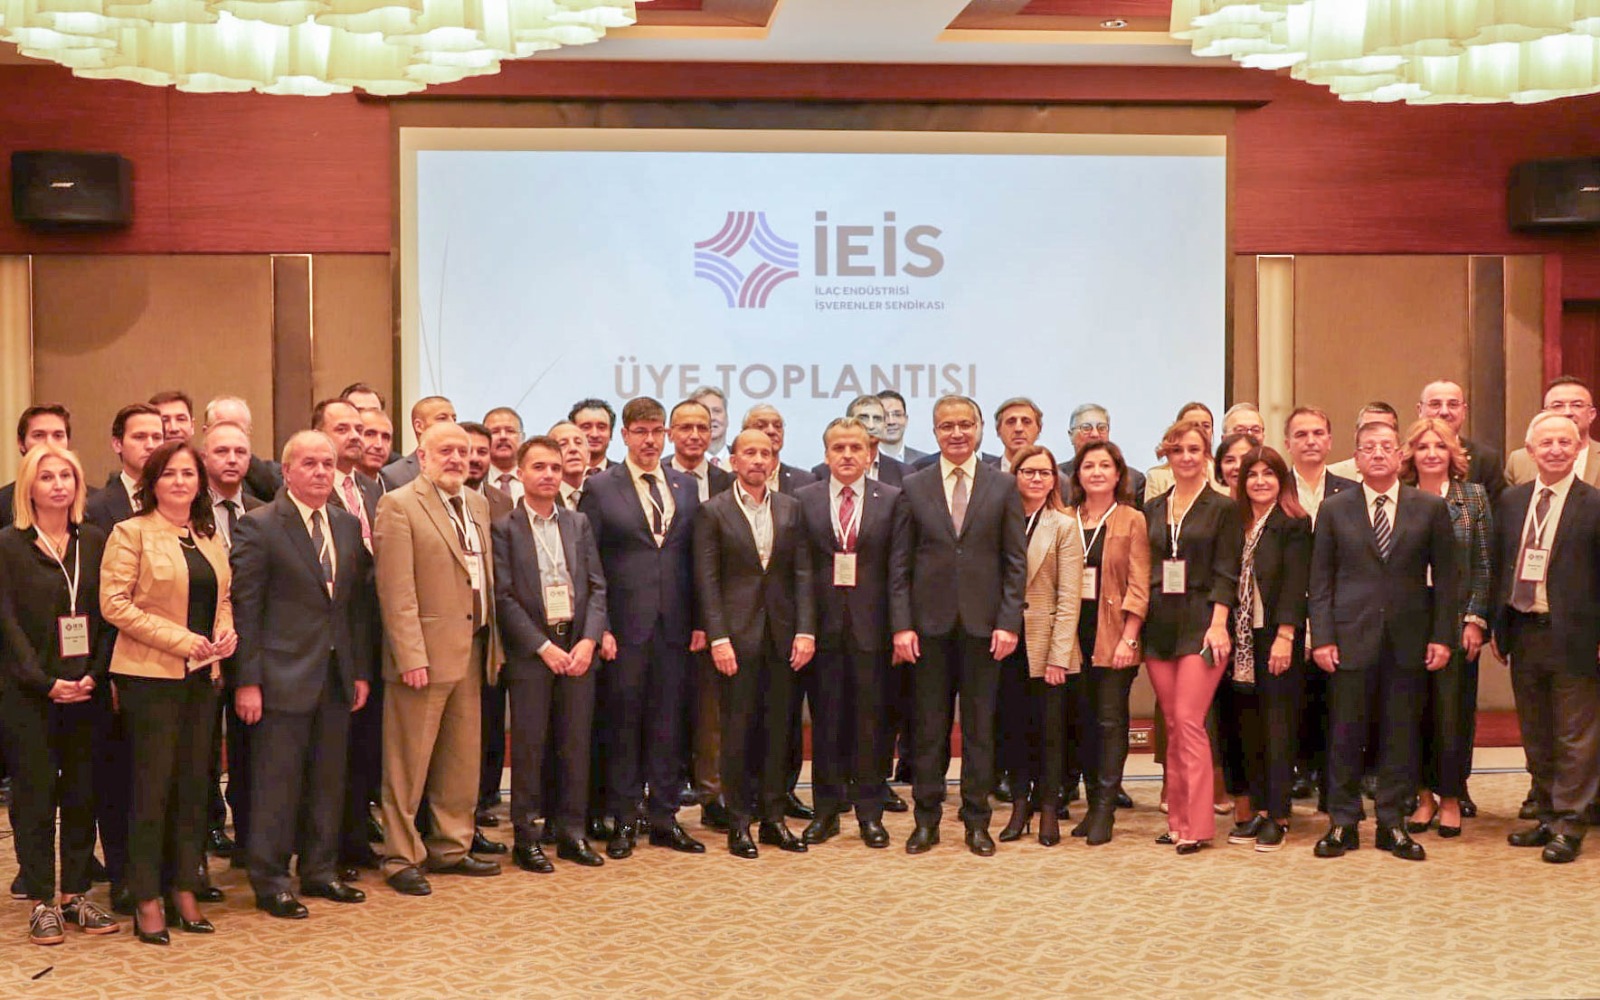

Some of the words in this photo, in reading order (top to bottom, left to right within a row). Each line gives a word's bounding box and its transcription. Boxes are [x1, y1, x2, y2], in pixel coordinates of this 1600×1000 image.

[814, 211, 945, 278] İEİS
[842, 285, 910, 296] ENDÜSTRİSİ
[814, 299, 883, 311] İŞVERENLER
[885, 299, 945, 310] SENDİKASI
[614, 356, 700, 400] ÜYE
[715, 363, 977, 399] TOPLANTISI
